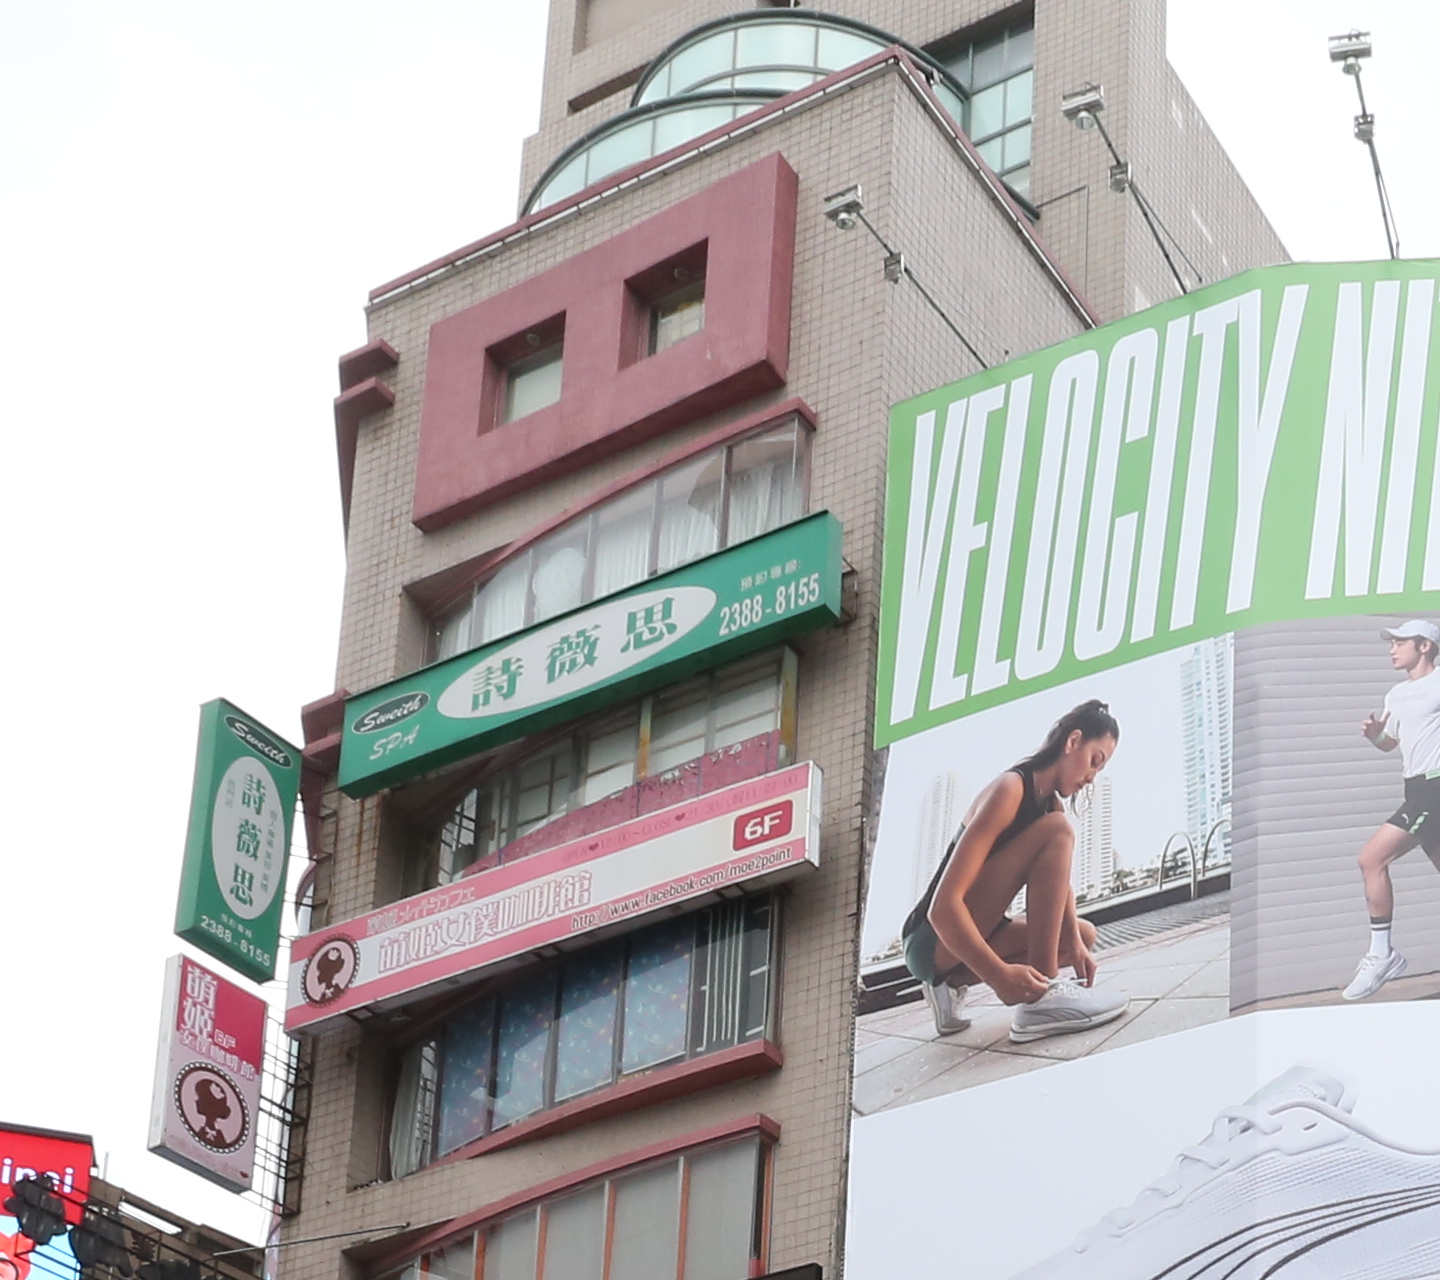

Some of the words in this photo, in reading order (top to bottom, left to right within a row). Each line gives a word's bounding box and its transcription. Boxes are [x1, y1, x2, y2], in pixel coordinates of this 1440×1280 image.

[894, 280, 1310, 722] VELOCITY
[719, 573, 821, 637] 2388-8155
[471, 596, 678, 712] 詩薇思
[369, 725, 421, 761] SPA
[230, 773, 267, 907] 詩薇思
[744, 810, 783, 841] 6F
[571, 847, 792, 931] http://www.facebook.com/moe2point
[200, 915, 271, 967] 2388-8155
